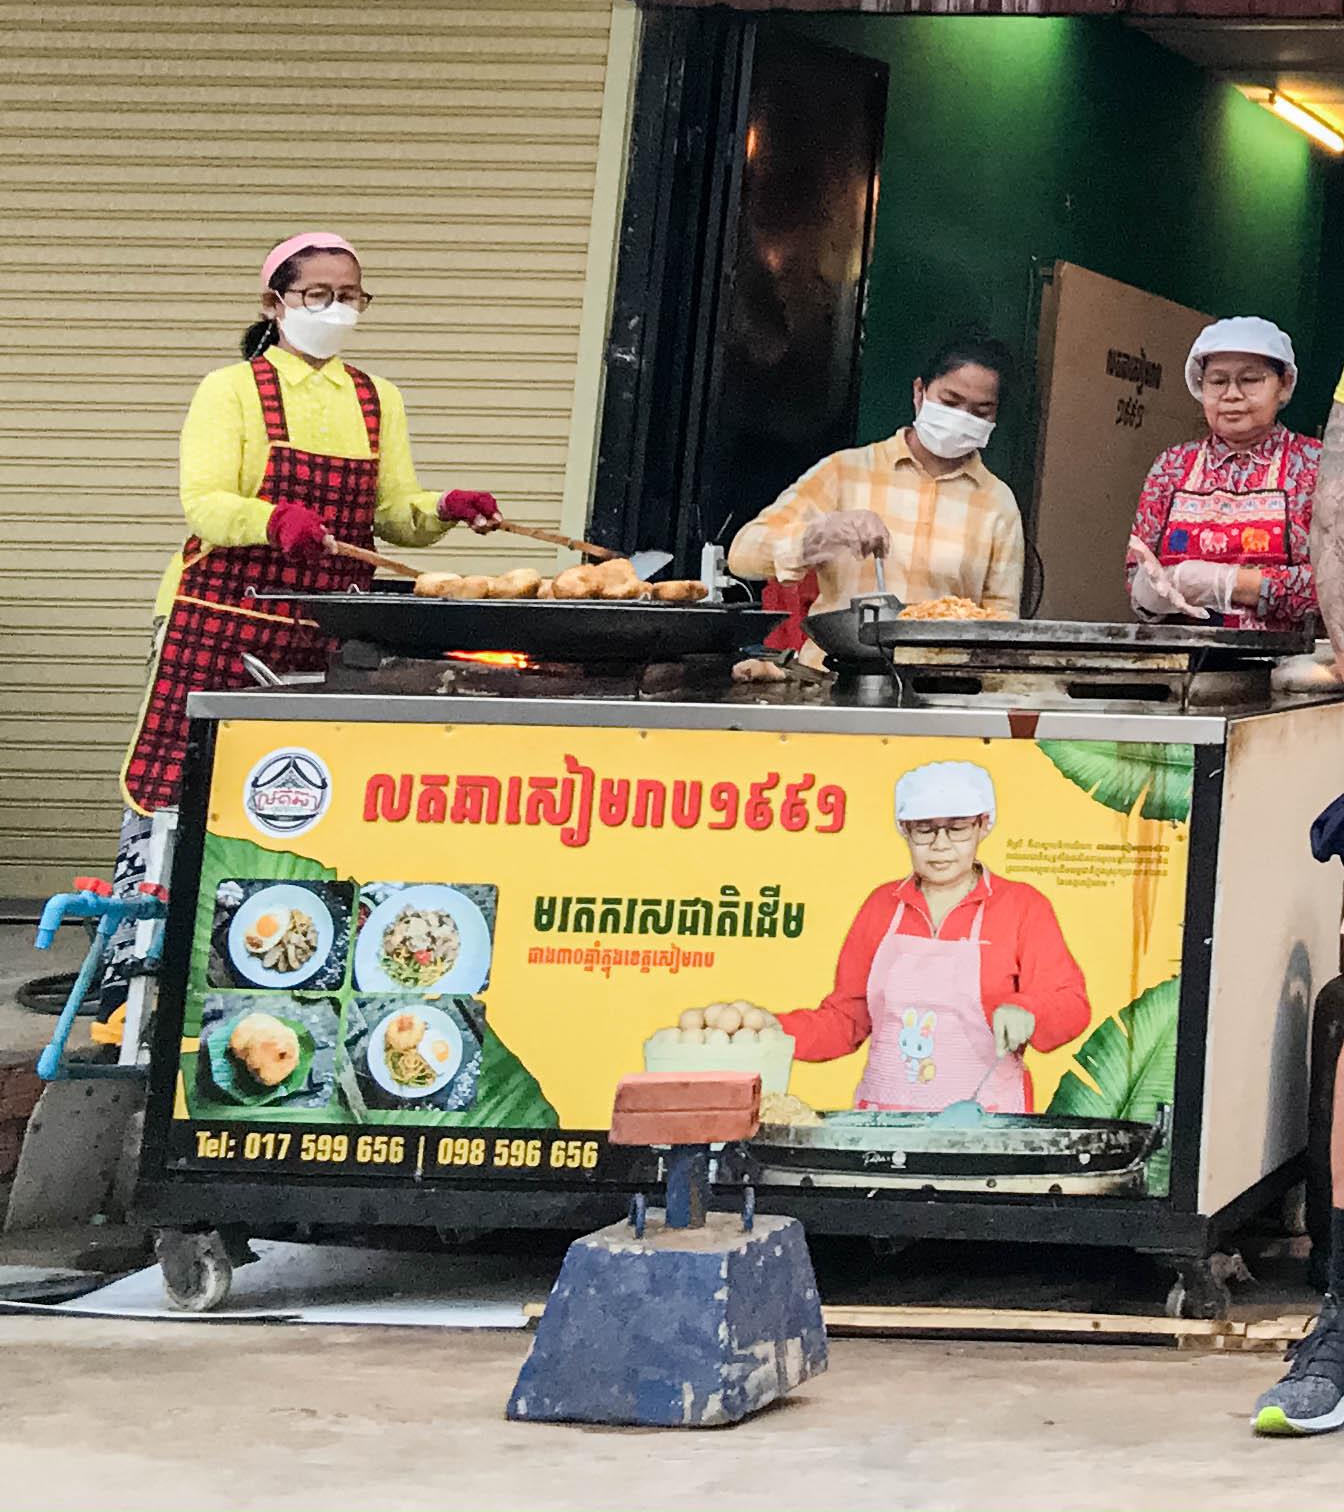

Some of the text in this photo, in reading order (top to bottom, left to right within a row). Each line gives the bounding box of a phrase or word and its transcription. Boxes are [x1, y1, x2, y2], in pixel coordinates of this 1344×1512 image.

[195, 1130, 236, 1160] Tel:
[243, 1132, 291, 1161] 017
[300, 1133, 349, 1163] 599
[356, 1135, 405, 1164] 656
[437, 1137, 486, 1167] 098
[493, 1138, 541, 1168] 596
[550, 1140, 599, 1169] 656
